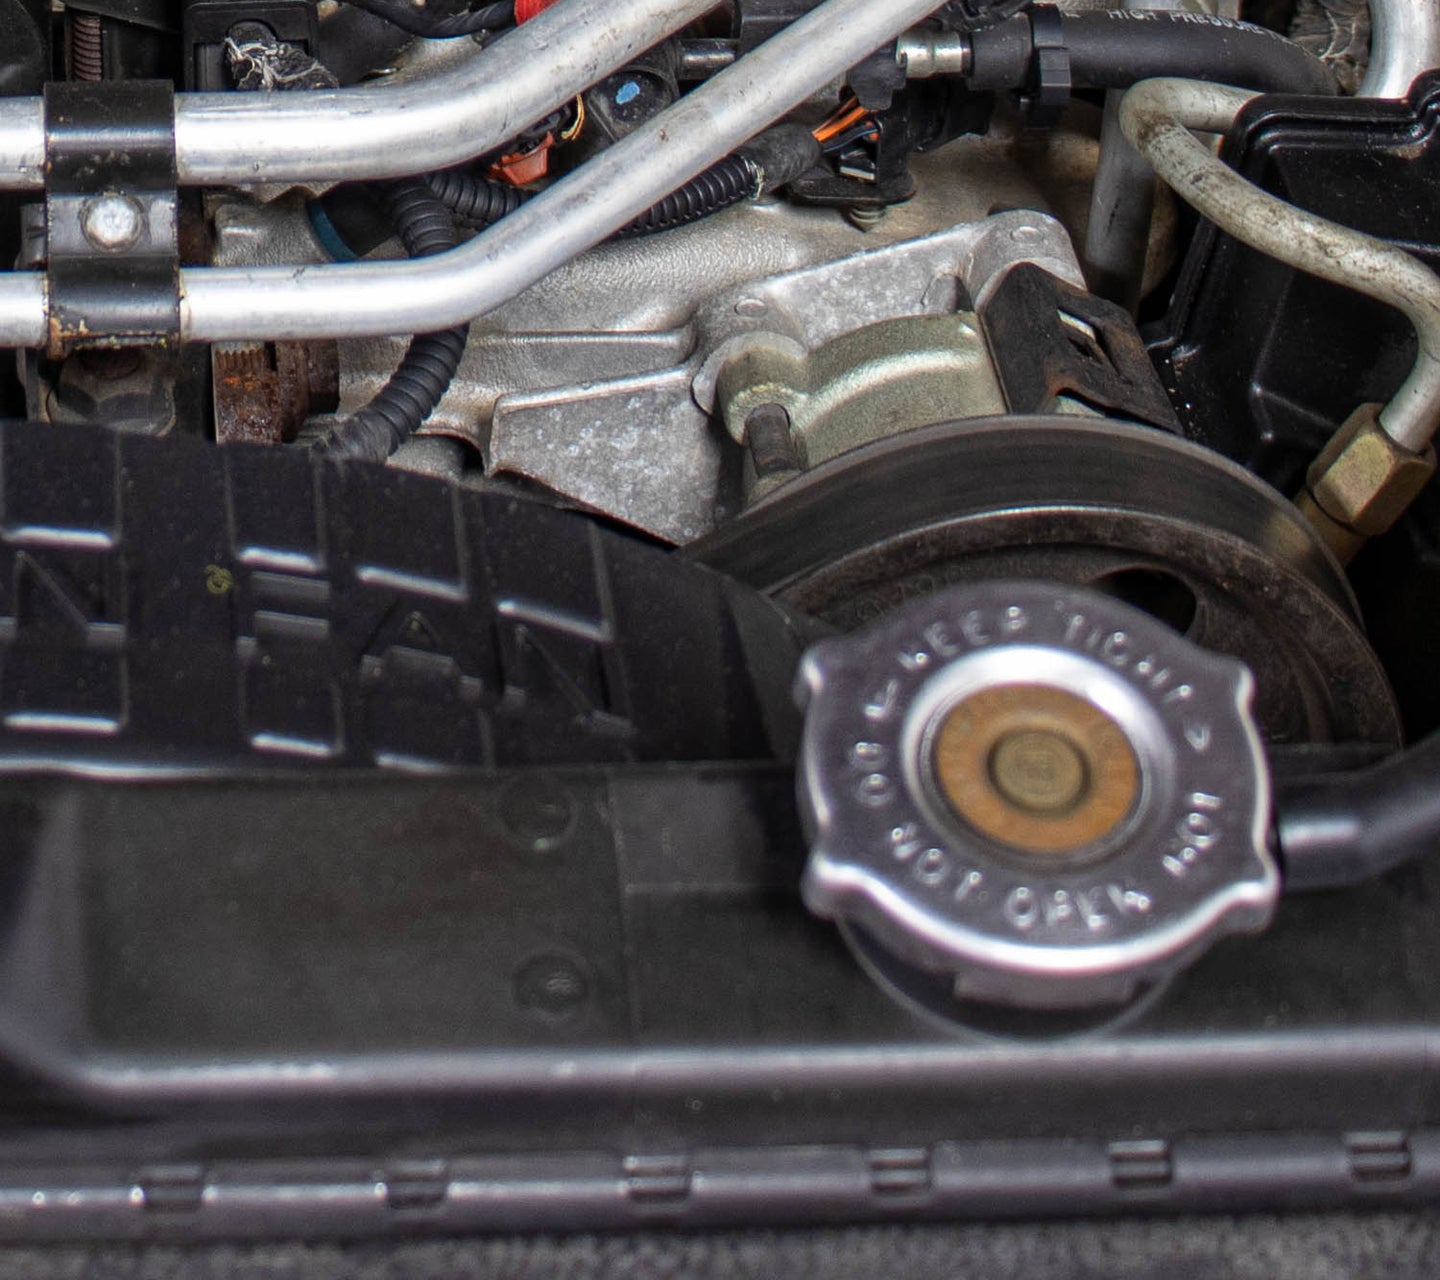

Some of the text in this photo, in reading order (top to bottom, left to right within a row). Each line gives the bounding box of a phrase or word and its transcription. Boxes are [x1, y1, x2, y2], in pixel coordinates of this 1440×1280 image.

[1106, 9, 1159, 23] HIGH
[246, 568, 640, 739] FAN
[1004, 883, 1154, 931] OPEN
